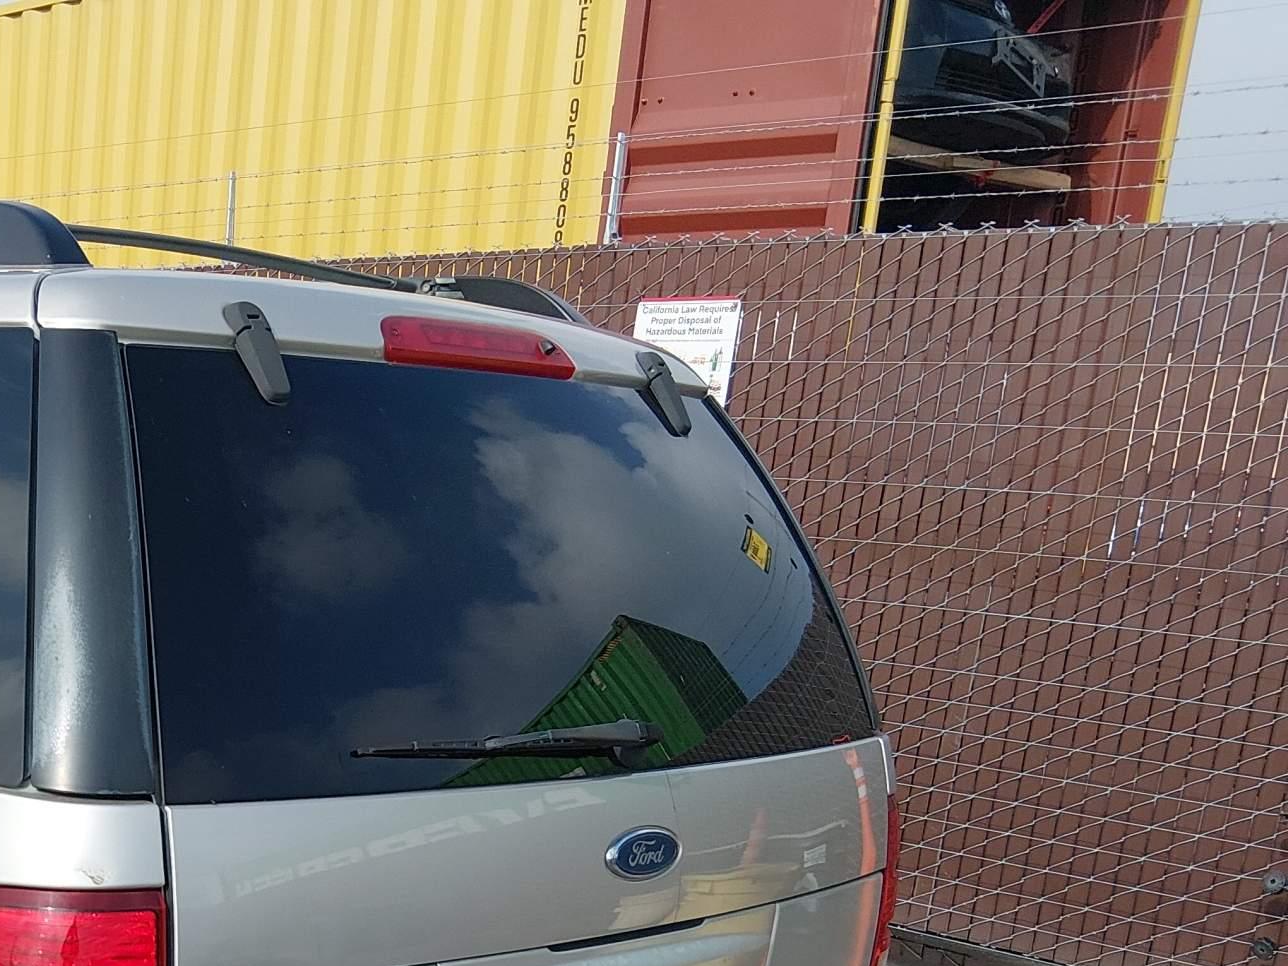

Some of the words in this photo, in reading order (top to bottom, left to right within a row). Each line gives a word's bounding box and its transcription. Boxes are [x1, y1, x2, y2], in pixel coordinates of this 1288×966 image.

[573, 0, 593, 86] EDU
[642, 304, 679, 314] California
[681, 305, 697, 314] Law
[699, 304, 735, 315] Requires
[650, 316, 677, 327] Proper
[678, 315, 712, 326] Disposal
[713, 315, 722, 324] of
[645, 327, 687, 336] Hazardous
[687, 326, 723, 336] Materials
[628, 840, 665, 867] Ford
